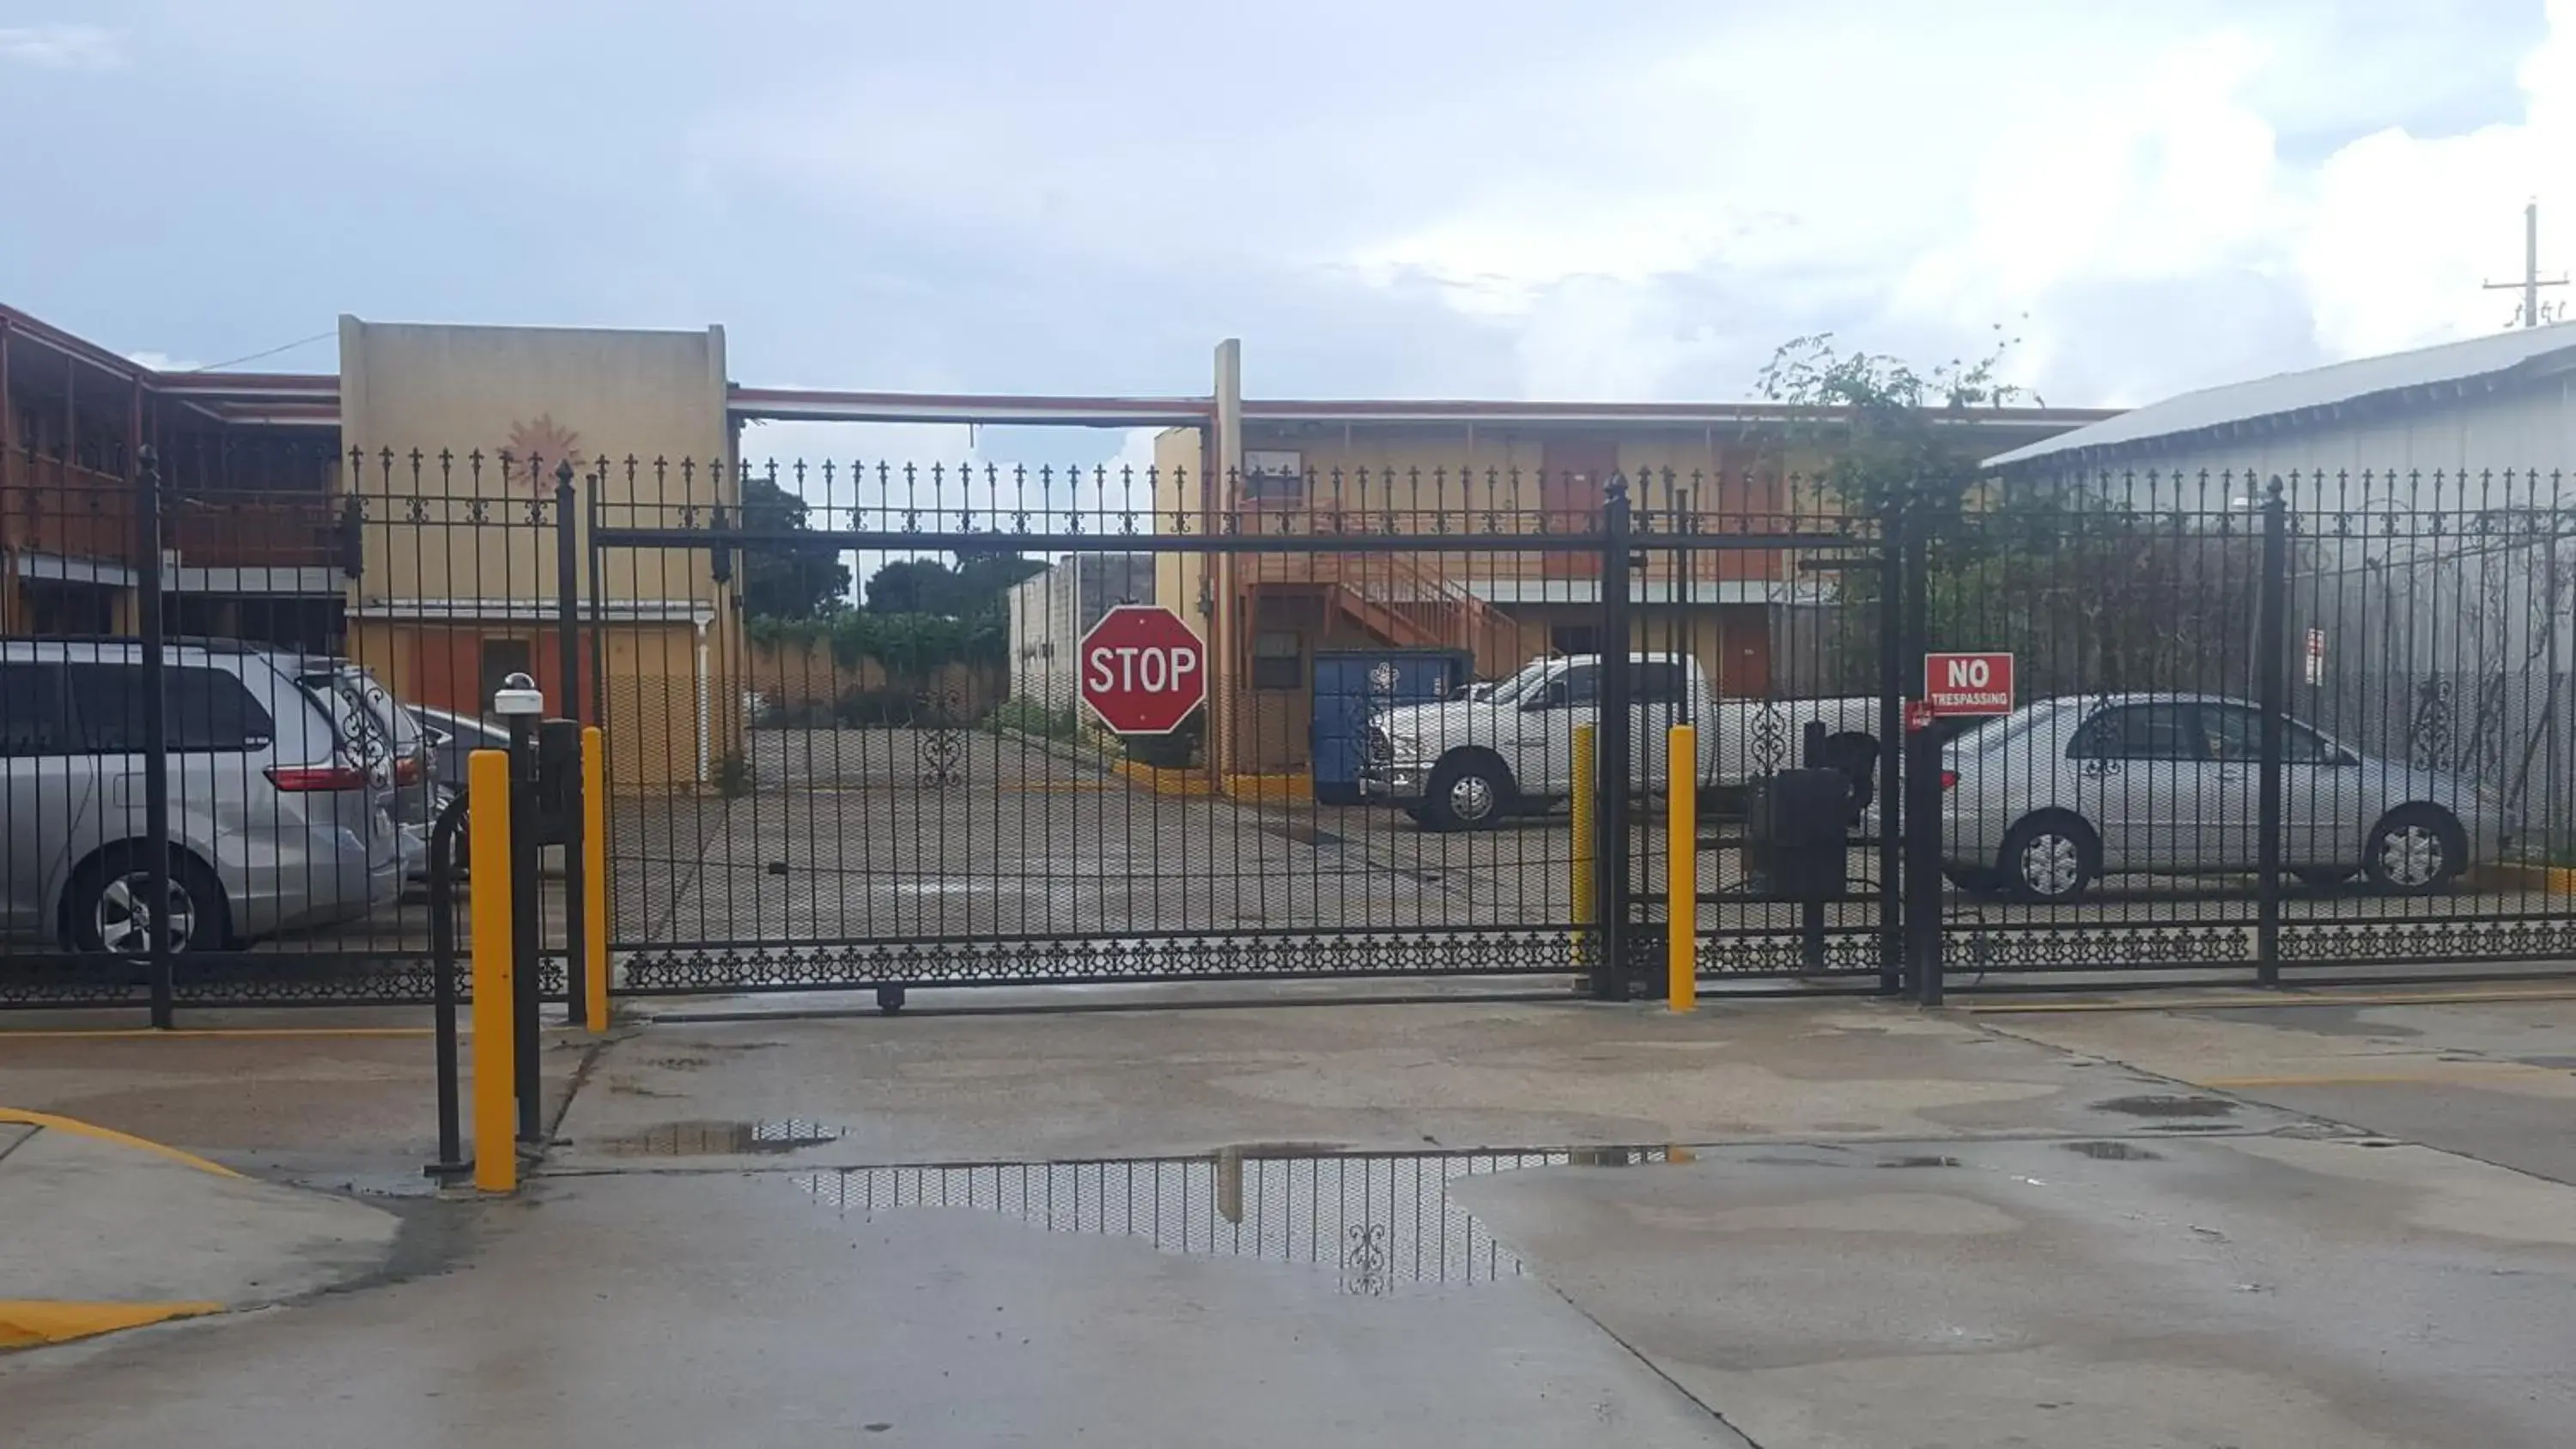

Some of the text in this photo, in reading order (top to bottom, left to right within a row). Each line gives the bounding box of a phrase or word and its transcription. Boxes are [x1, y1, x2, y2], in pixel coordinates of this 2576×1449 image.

[1089, 647, 1196, 693] STOP
[1948, 658, 1990, 688] NO
[1931, 693, 2008, 706] TRESPASSING
